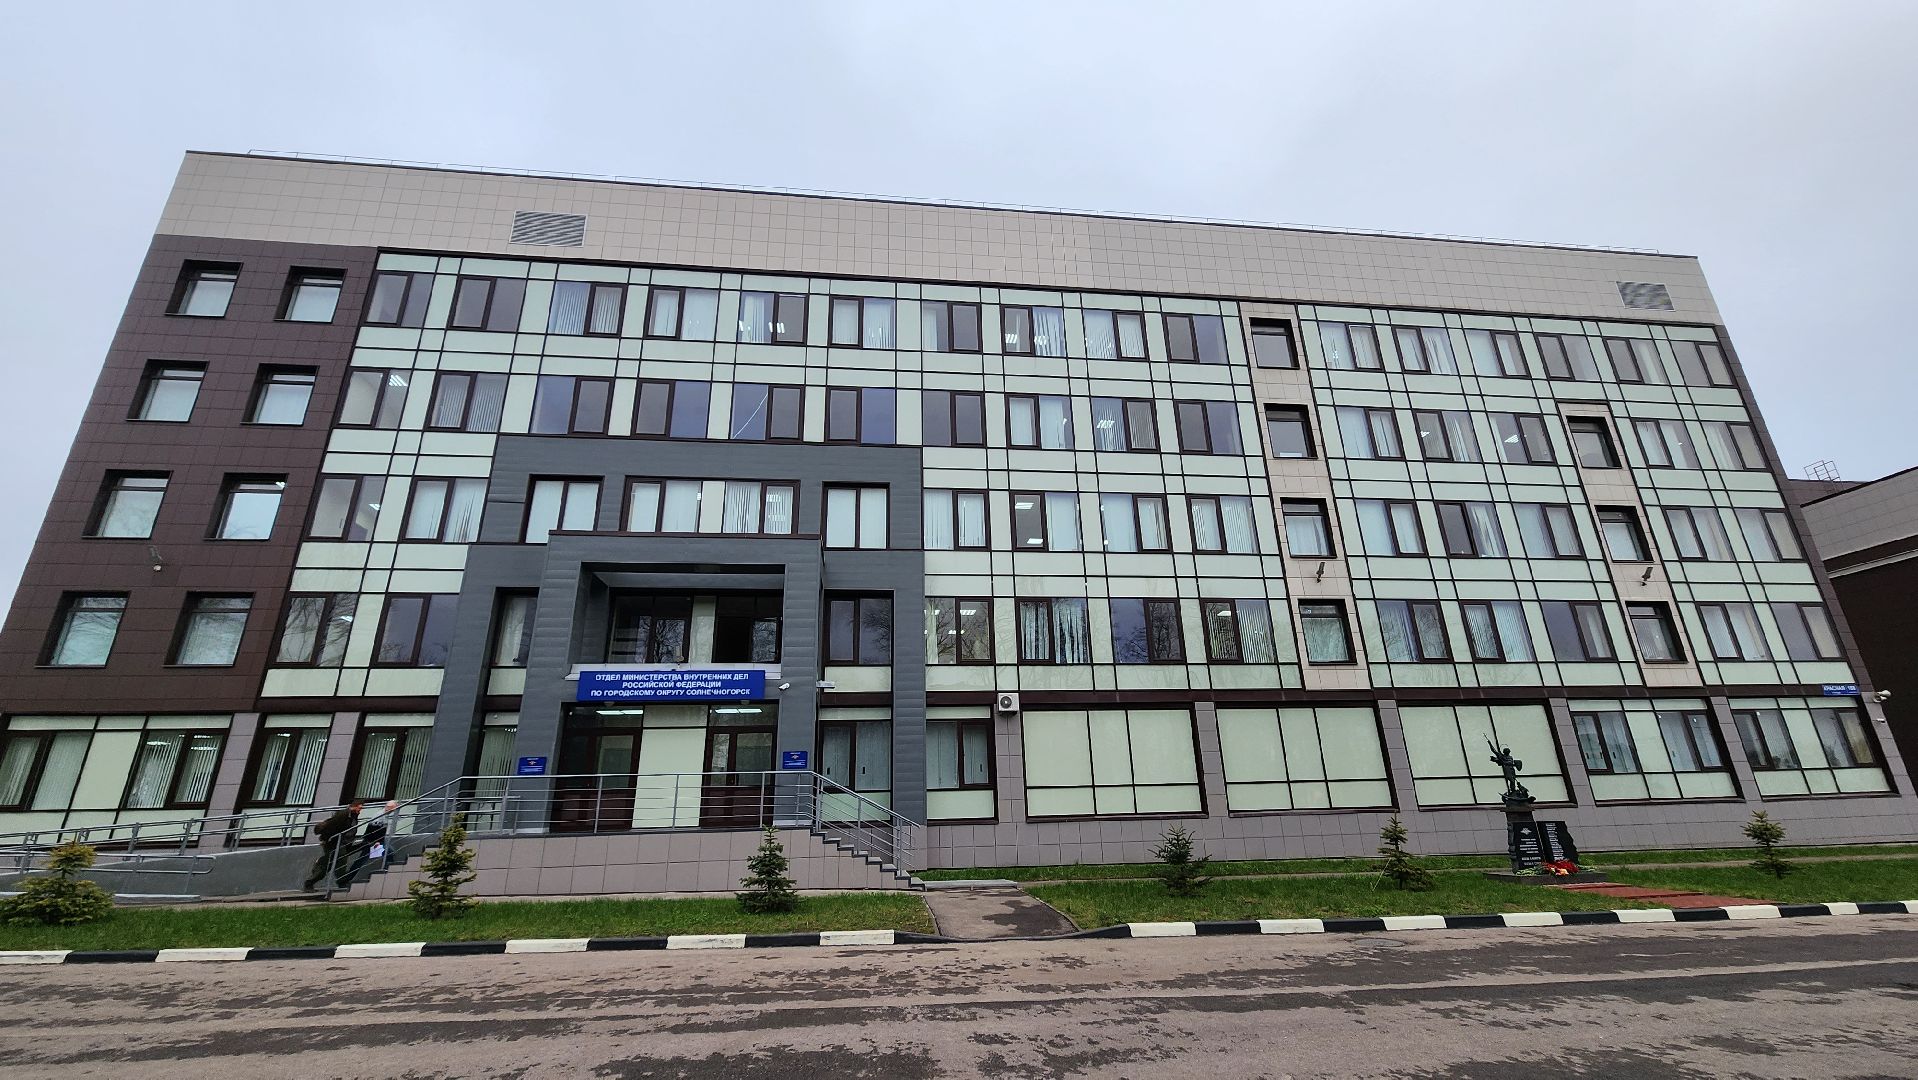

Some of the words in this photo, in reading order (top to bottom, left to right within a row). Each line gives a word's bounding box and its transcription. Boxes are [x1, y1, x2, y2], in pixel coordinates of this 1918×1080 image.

[595, 674, 621, 682] ОТДЕЛ
[622, 673, 682, 681] МИНИСТЕРСТВА
[683, 673, 732, 681] ВНУТРЕННИХ
[733, 673, 749, 681] ДЕЛ
[622, 681, 674, 689] РОССИЙСКОЙ
[675, 681, 721, 689] ФЕДЕРАЦИИ
[603, 689, 655, 697] ГОРОДСКОМУ
[686, 688, 751, 696] СОЛНЕЧНОГОРСК
